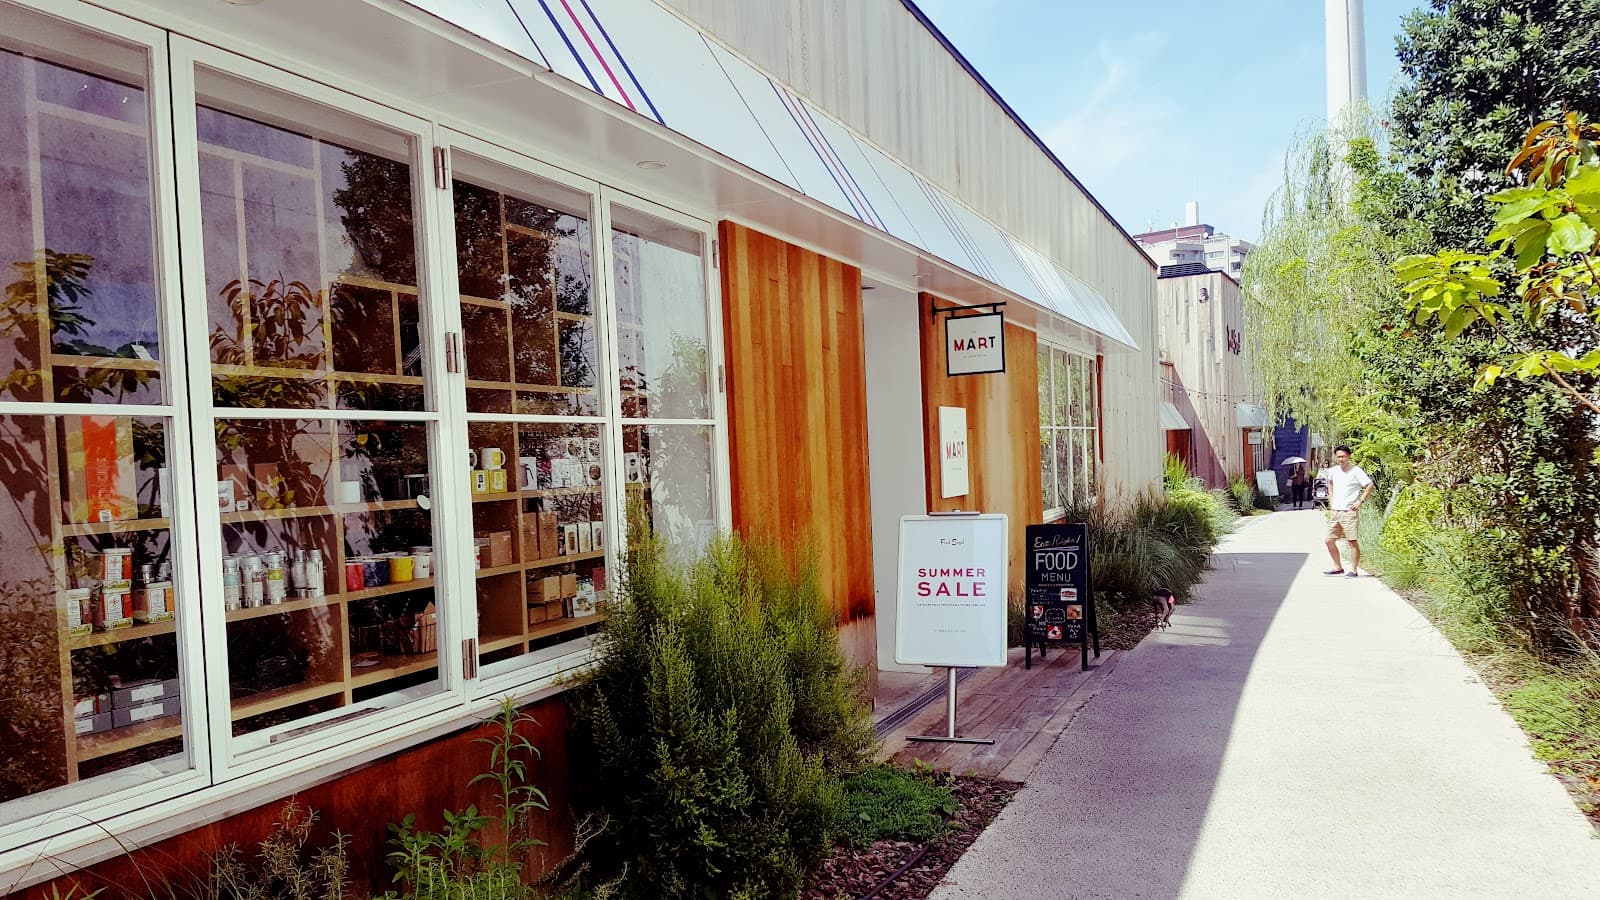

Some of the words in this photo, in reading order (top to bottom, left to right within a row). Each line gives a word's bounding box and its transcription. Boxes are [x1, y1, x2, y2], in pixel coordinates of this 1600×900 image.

[953, 336, 996, 351] MART
[946, 440, 964, 460] MART
[1035, 552, 1078, 571] FOOD
[918, 568, 985, 578] SUMMER
[1041, 573, 1071, 583] MENU
[917, 582, 986, 597] SALE
